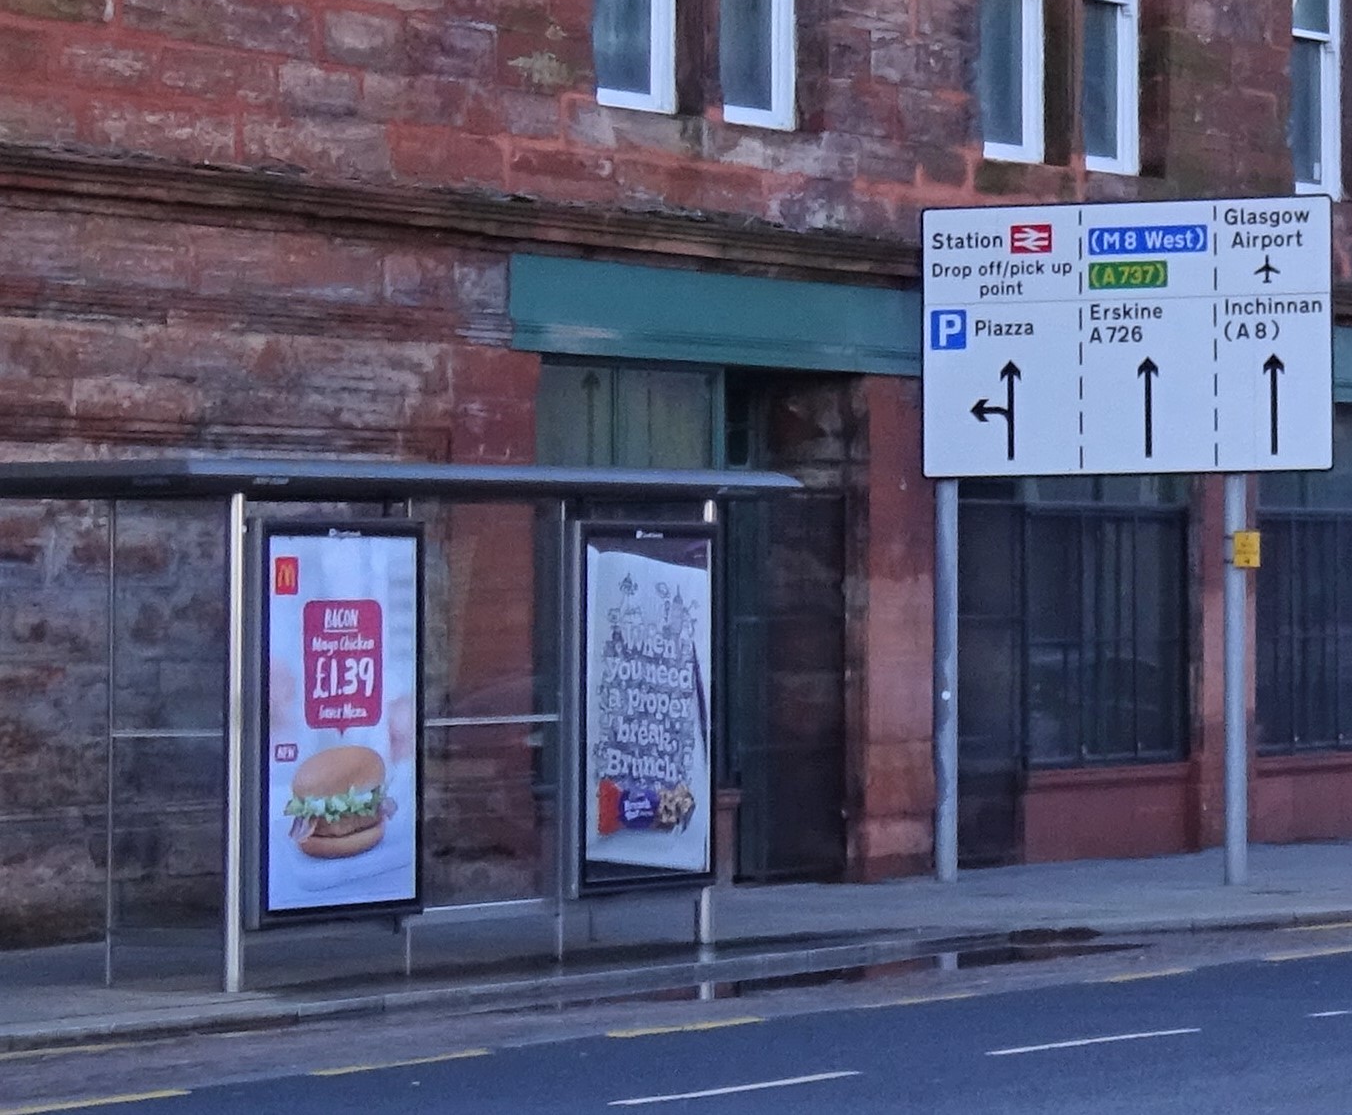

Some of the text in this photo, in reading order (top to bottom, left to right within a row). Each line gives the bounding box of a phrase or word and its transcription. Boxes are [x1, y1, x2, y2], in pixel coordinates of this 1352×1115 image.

[1224, 208, 1310, 227] Glasgow
[932, 232, 1003, 250] Station
[1145, 227, 1204, 250] West)
[1231, 229, 1303, 250] Airport
[931, 260, 1072, 279] Drop off/pick up
[979, 281, 1023, 298] point
[1090, 303, 1163, 320] Erskine
[1224, 297, 1323, 315] Inchinnan
[938, 313, 1034, 347] P Piazza
[324, 608, 359, 629] BACON
[623, 624, 676, 659] When
[312, 657, 374, 699] £1.39
[605, 656, 694, 692] you need
[627, 688, 691, 721] proper
